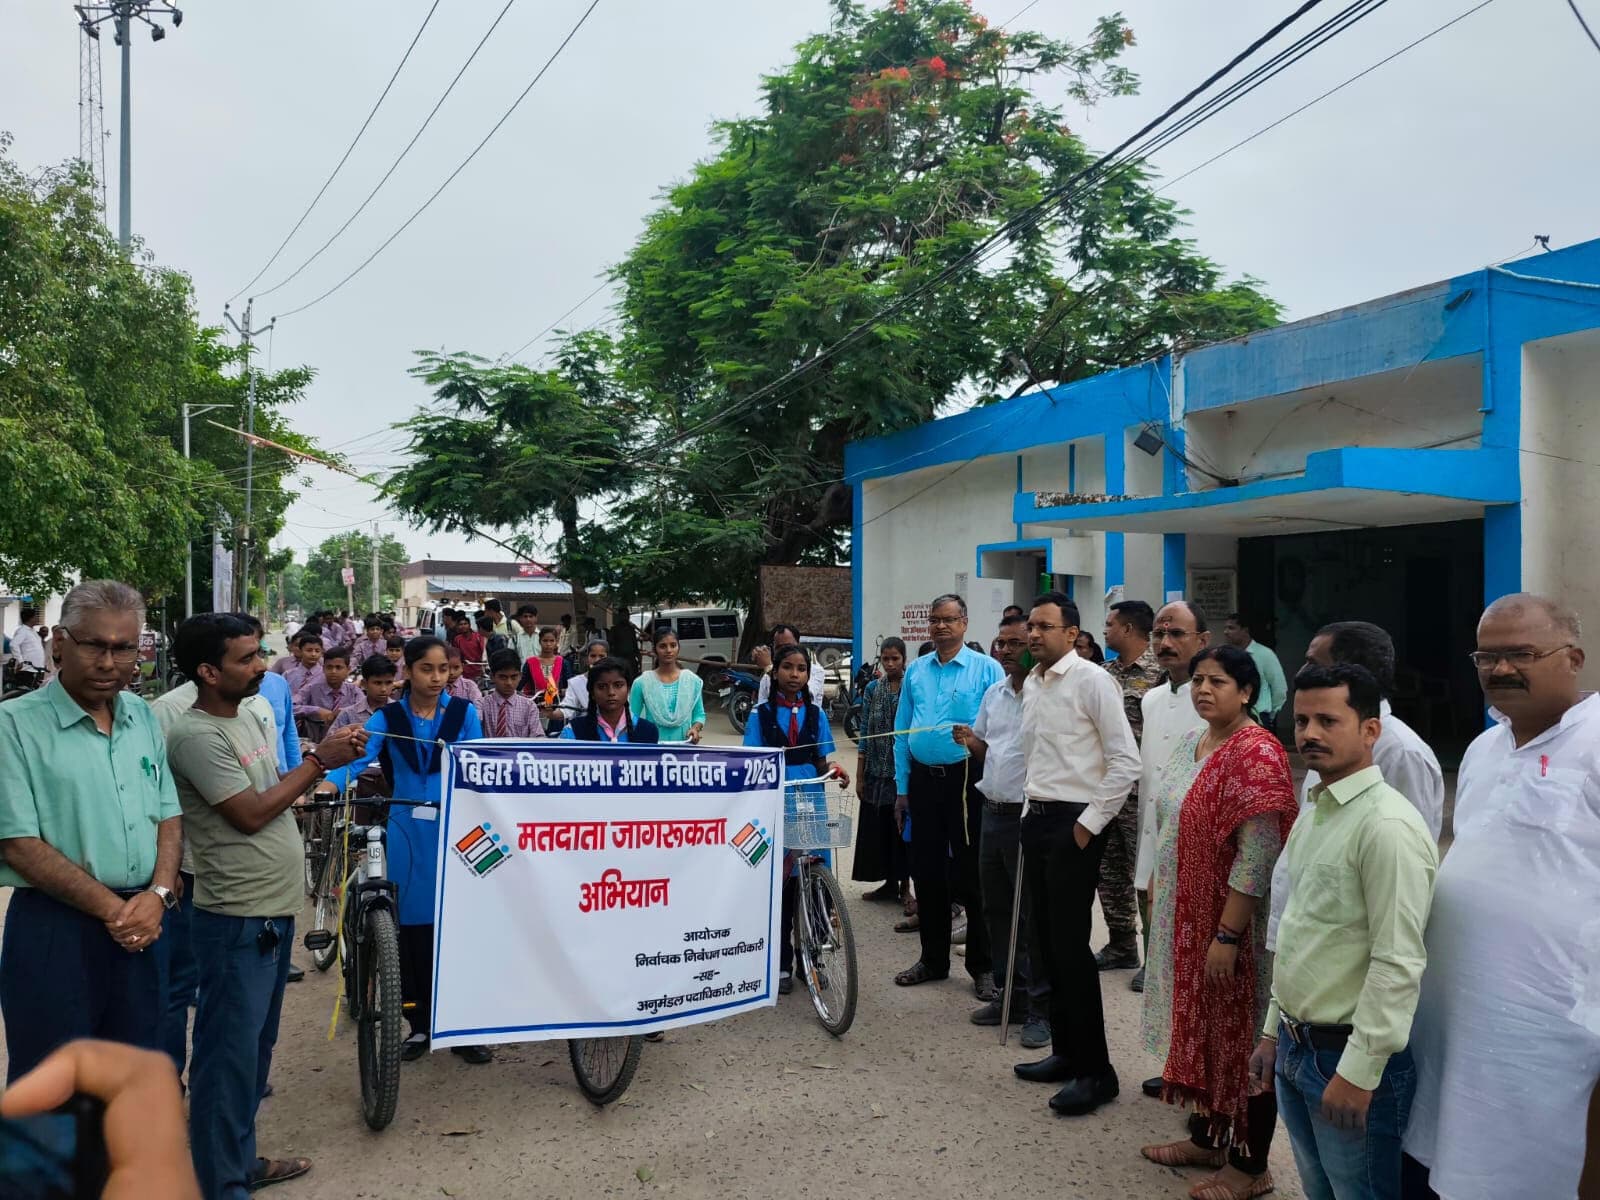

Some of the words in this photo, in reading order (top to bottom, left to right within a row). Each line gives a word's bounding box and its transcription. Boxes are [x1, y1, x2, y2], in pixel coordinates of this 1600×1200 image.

[459, 749, 514, 786] बिहार
[515, 751, 614, 787] विधानसभा
[618, 759, 658, 787] आम
[660, 753, 728, 787] निर्वाचन
[743, 758, 777, 786] 2025
[516, 821, 608, 852] मतदाता
[610, 818, 728, 849] जागरूकता
[578, 868, 671, 913] अभियान
[683, 927, 732, 942] आयोजक
[635, 951, 682, 968] निर्वाचक
[683, 948, 720, 963] निबंधन
[721, 937, 765, 957] पदाधिकारी
[636, 994, 684, 1014] अनुमंडल
